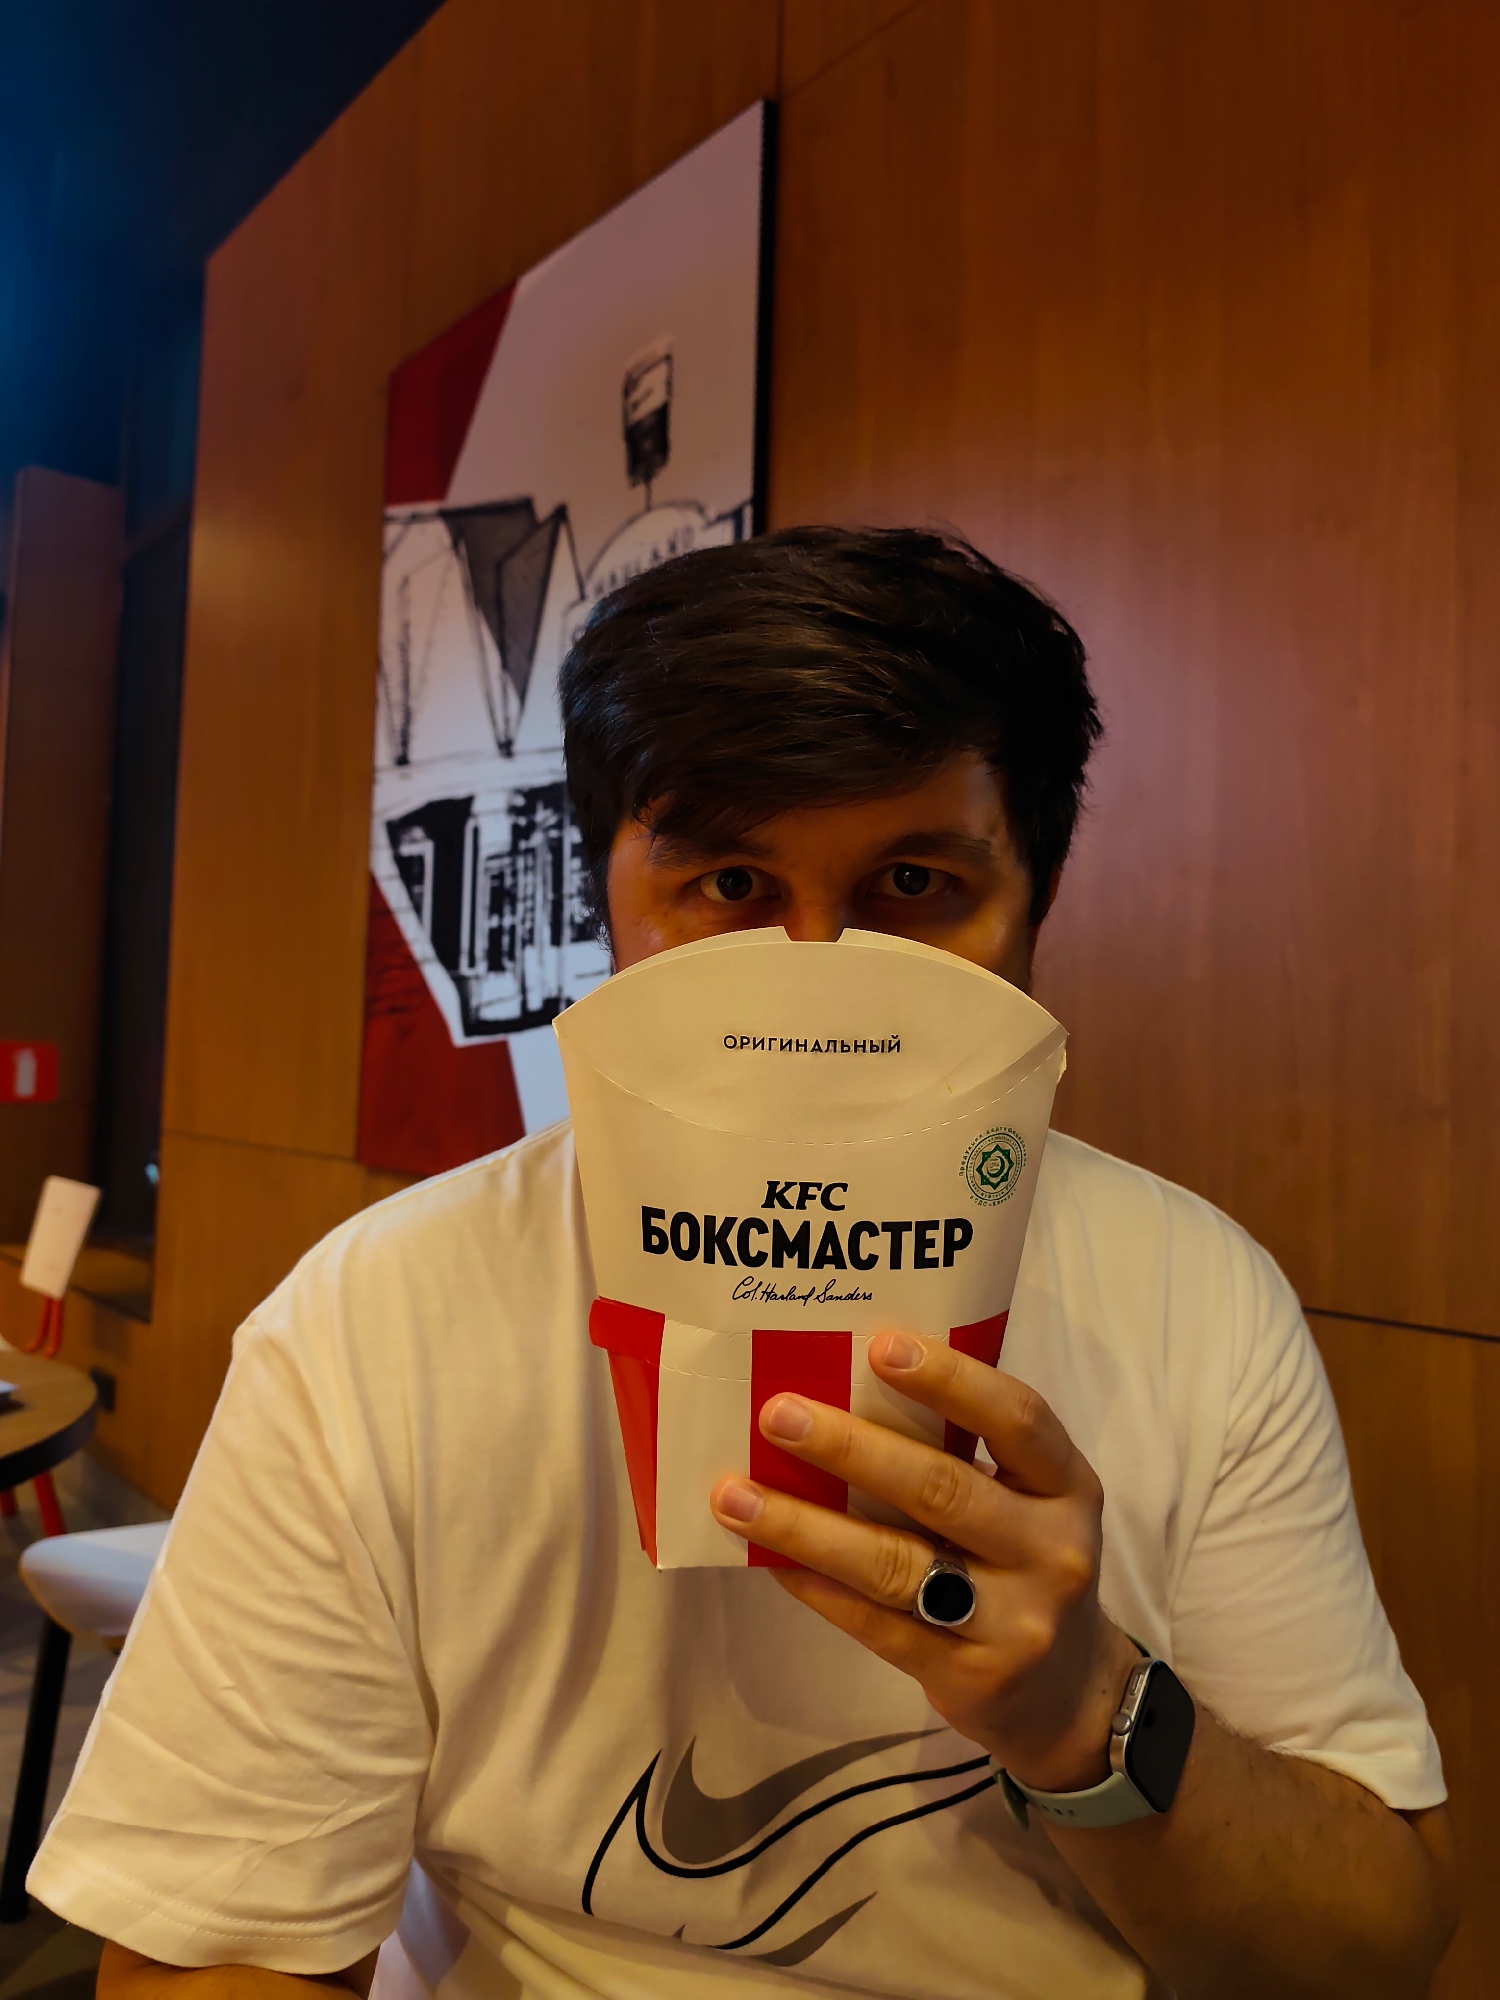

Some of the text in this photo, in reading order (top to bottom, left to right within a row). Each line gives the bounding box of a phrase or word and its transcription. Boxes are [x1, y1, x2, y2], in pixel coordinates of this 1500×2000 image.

[723, 1034, 901, 1053] ОРИГИНАЛЬНЫЙ
[760, 1180, 849, 1211] KFC
[641, 1205, 974, 1271] БОКСМАСТЕР
[760, 1283, 816, 1307] Harland
[814, 1278, 873, 1304] Sanders
